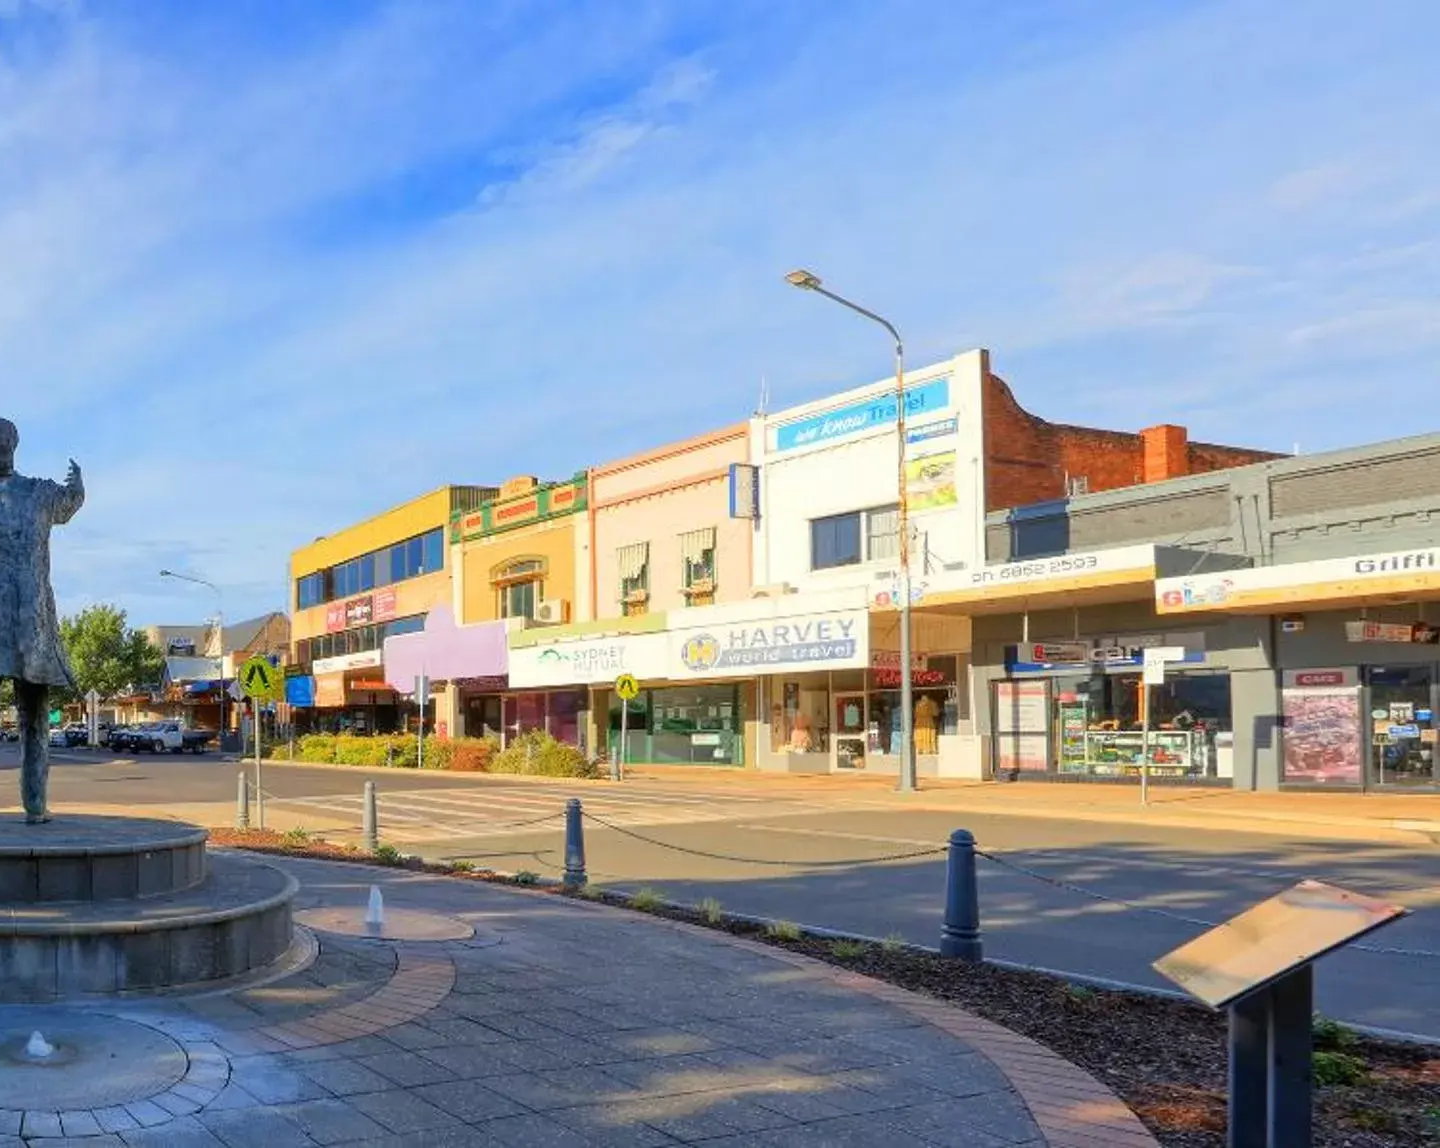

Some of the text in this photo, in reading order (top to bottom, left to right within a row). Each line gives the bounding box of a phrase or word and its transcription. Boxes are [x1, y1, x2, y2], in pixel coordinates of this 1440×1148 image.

[729, 618, 855, 647] HARVEY
[572, 645, 627, 661] SYDNEY
[728, 642, 852, 663] world travel
[573, 657, 628, 672] MUTUAL
